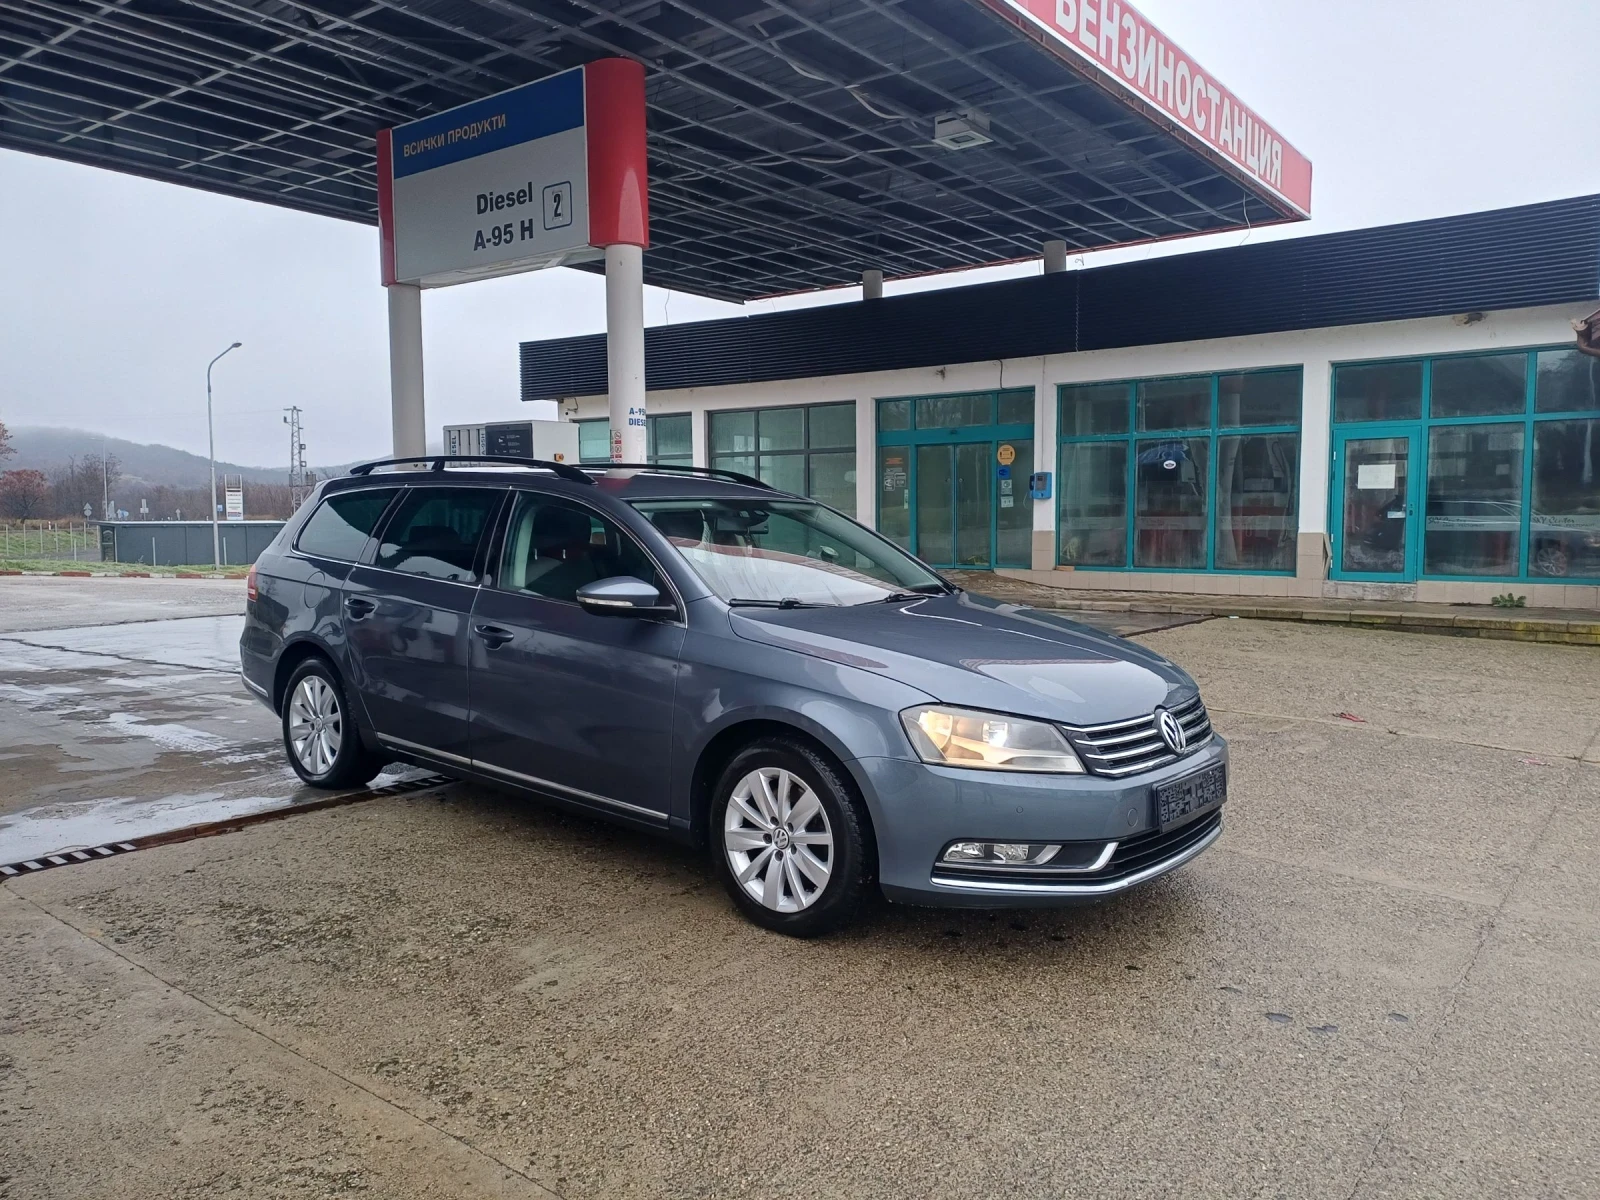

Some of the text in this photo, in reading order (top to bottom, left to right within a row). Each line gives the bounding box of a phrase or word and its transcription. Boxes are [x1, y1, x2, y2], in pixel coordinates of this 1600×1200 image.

[403, 114, 506, 157] ВСИЧКИ ПРОДУКТИ
[476, 182, 533, 215] Diesel
[553, 193, 561, 218] 2
[473, 223, 513, 251] A-95
